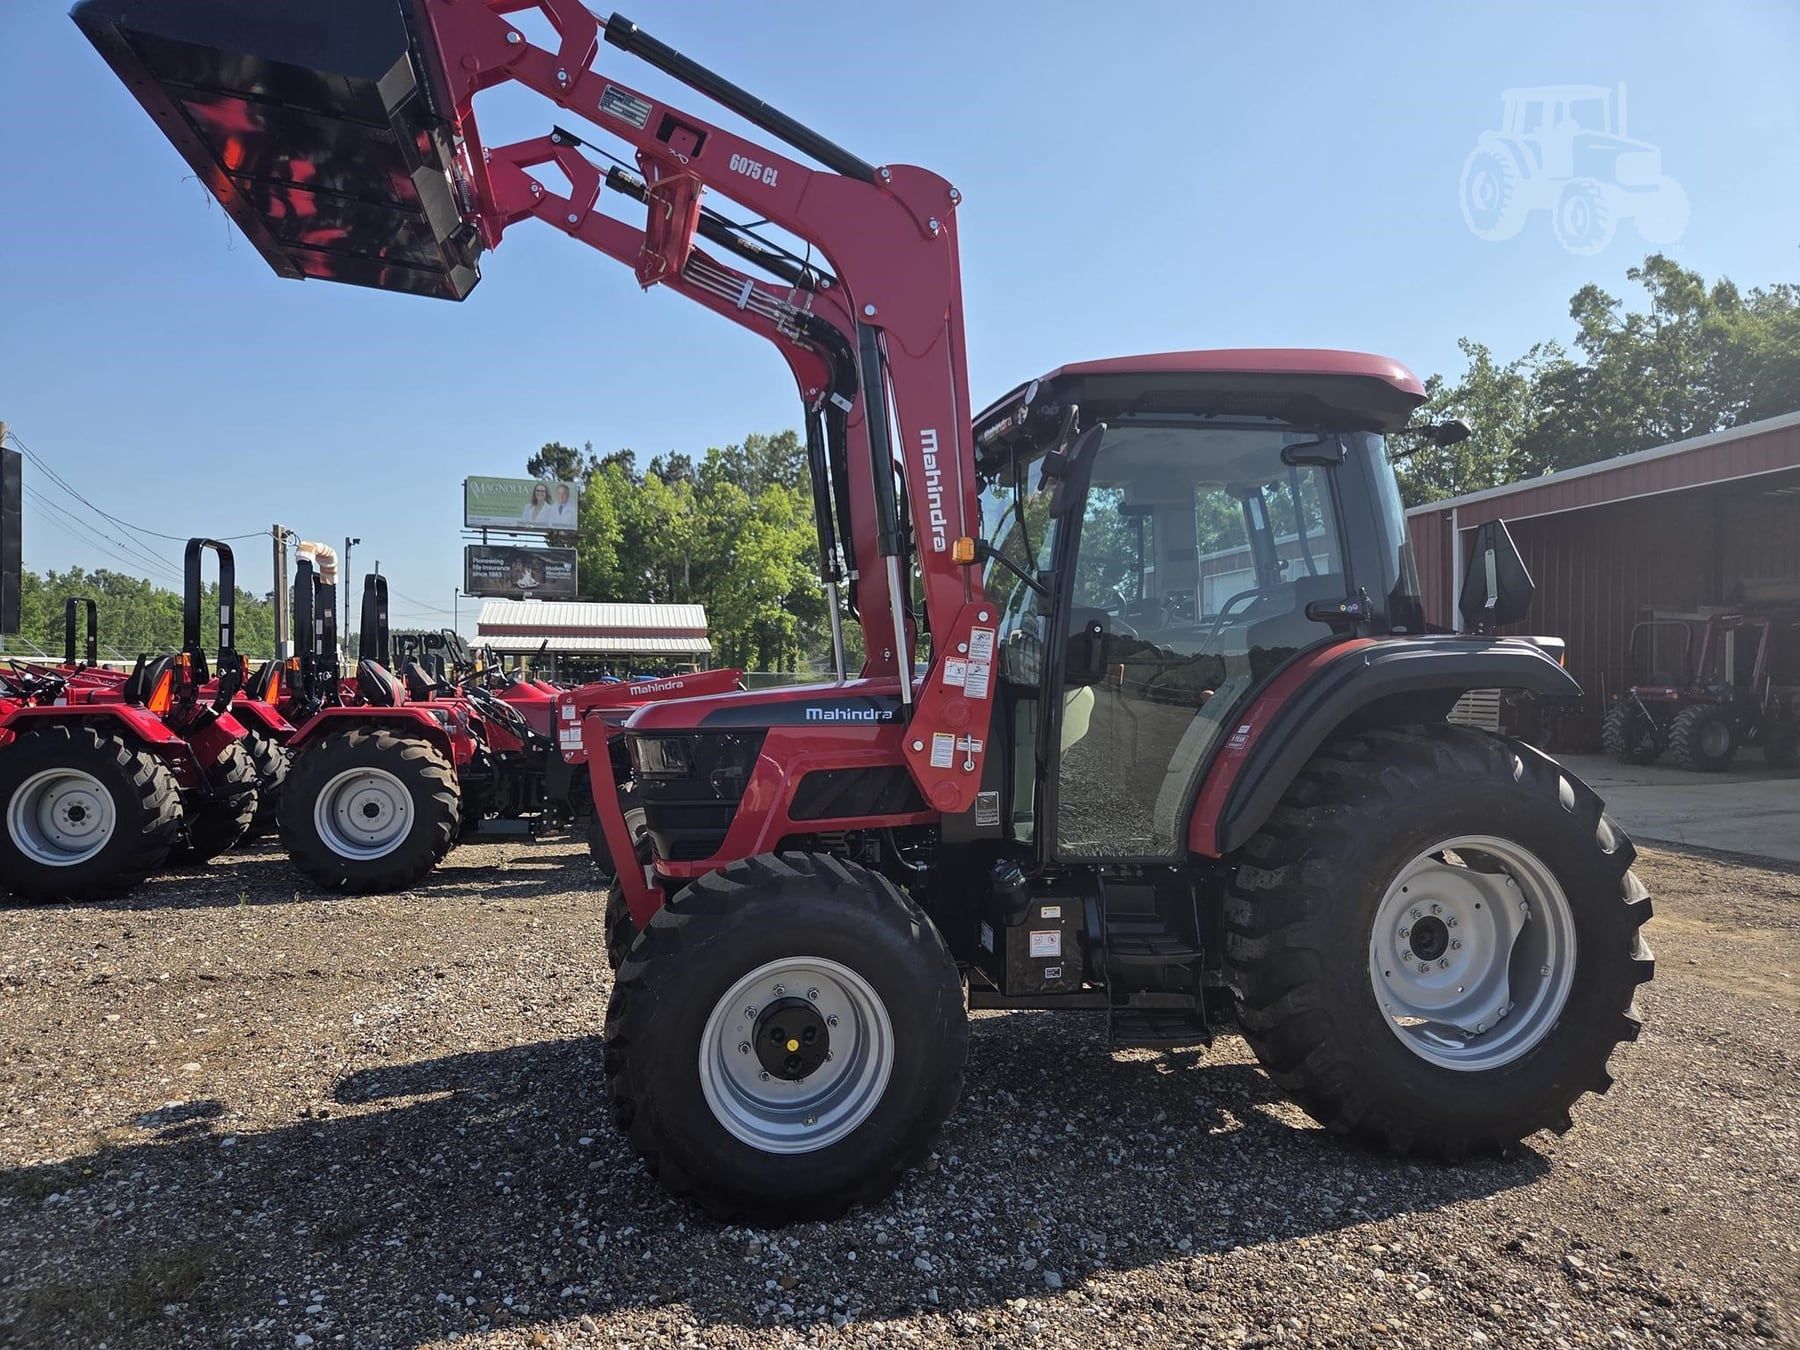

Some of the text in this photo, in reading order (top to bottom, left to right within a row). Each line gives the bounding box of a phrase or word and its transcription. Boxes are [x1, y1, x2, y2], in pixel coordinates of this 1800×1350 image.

[729, 153, 778, 187] 6075 CL
[472, 557, 505, 566] Pioneering
